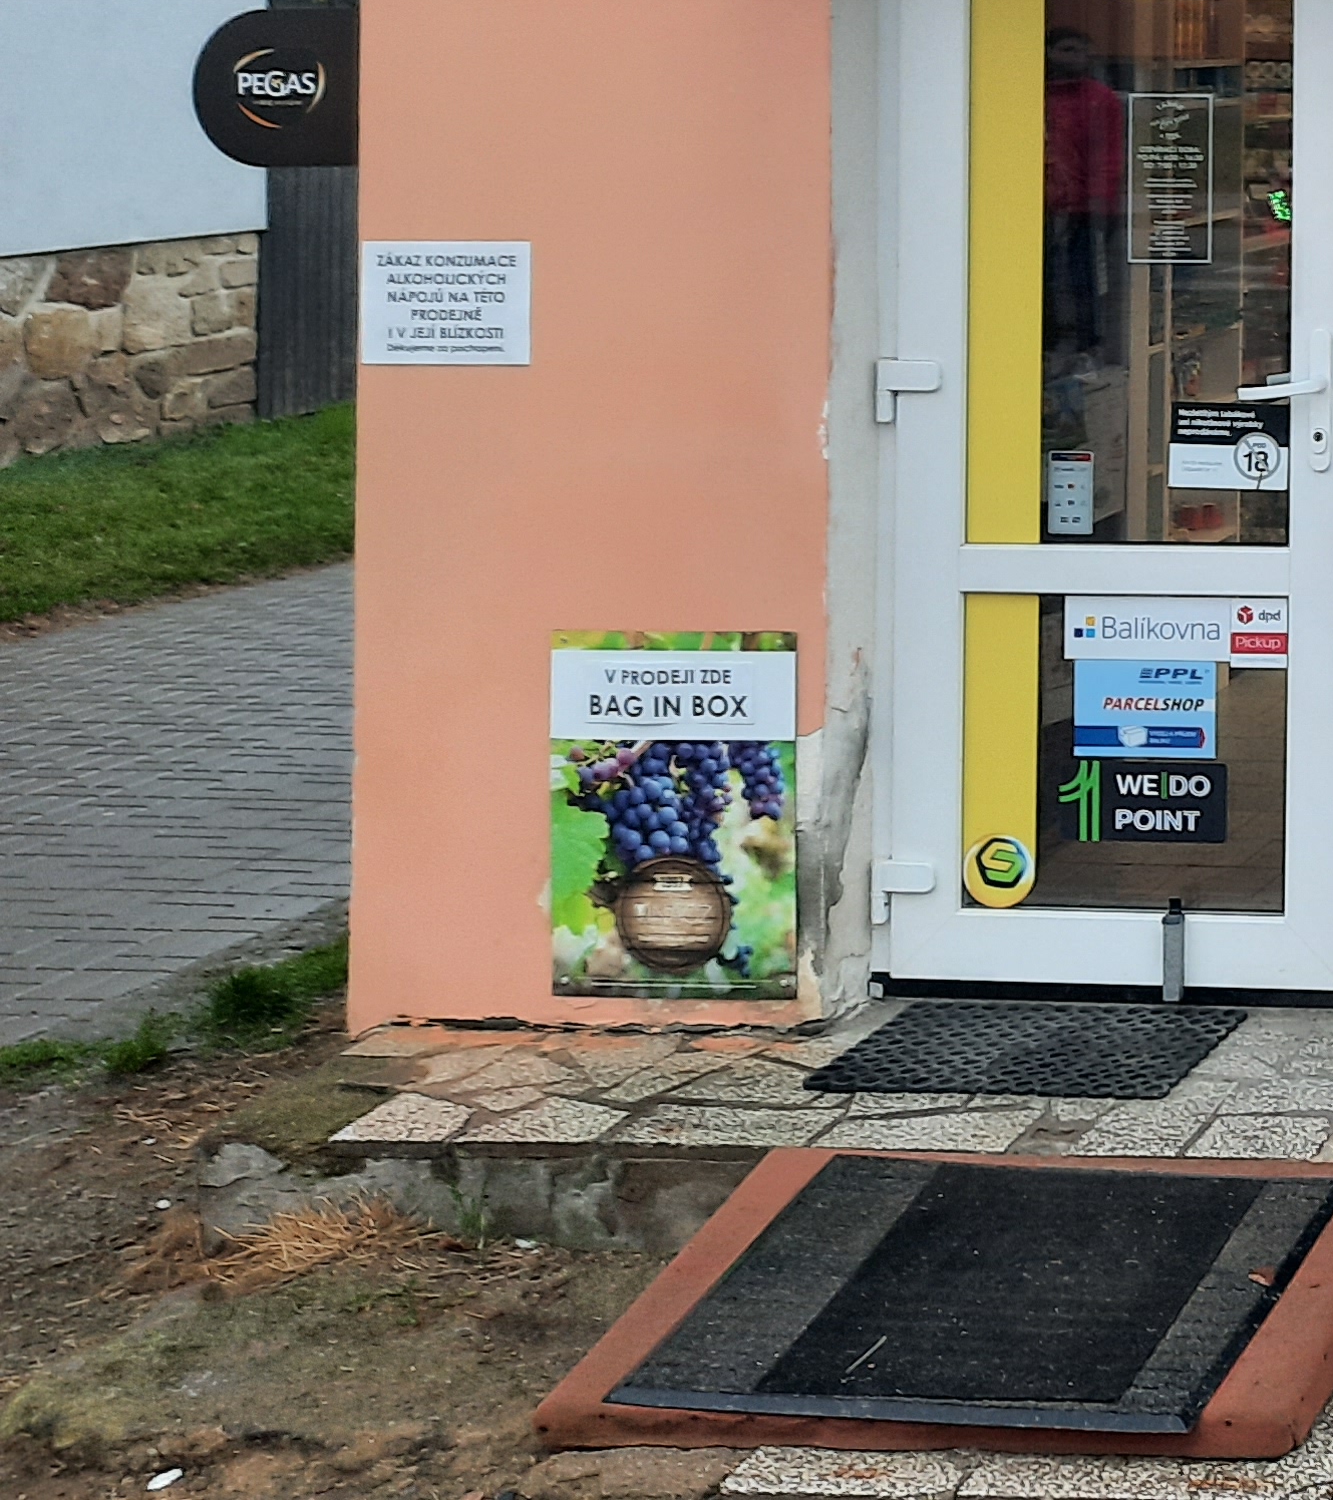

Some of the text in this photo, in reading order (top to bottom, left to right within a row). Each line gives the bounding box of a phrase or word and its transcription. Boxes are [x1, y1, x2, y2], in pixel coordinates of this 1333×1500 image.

[237, 71, 316, 97] PEGAS
[377, 252, 517, 267] ZÁKAZ KONZUMACE
[448, 292, 469, 302] NA
[1243, 451, 1270, 472] 18
[1258, 609, 1281, 623] dpd
[1101, 615, 1221, 641] Balíkovna
[1235, 636, 1281, 649] Pickup
[604, 669, 732, 685] V PRODEJI ZDE
[1154, 668, 1204, 680] PPL
[589, 695, 748, 718] BAG IN BOX
[1103, 697, 1205, 712] PARCELSHOP
[1114, 809, 1201, 831] POINT
